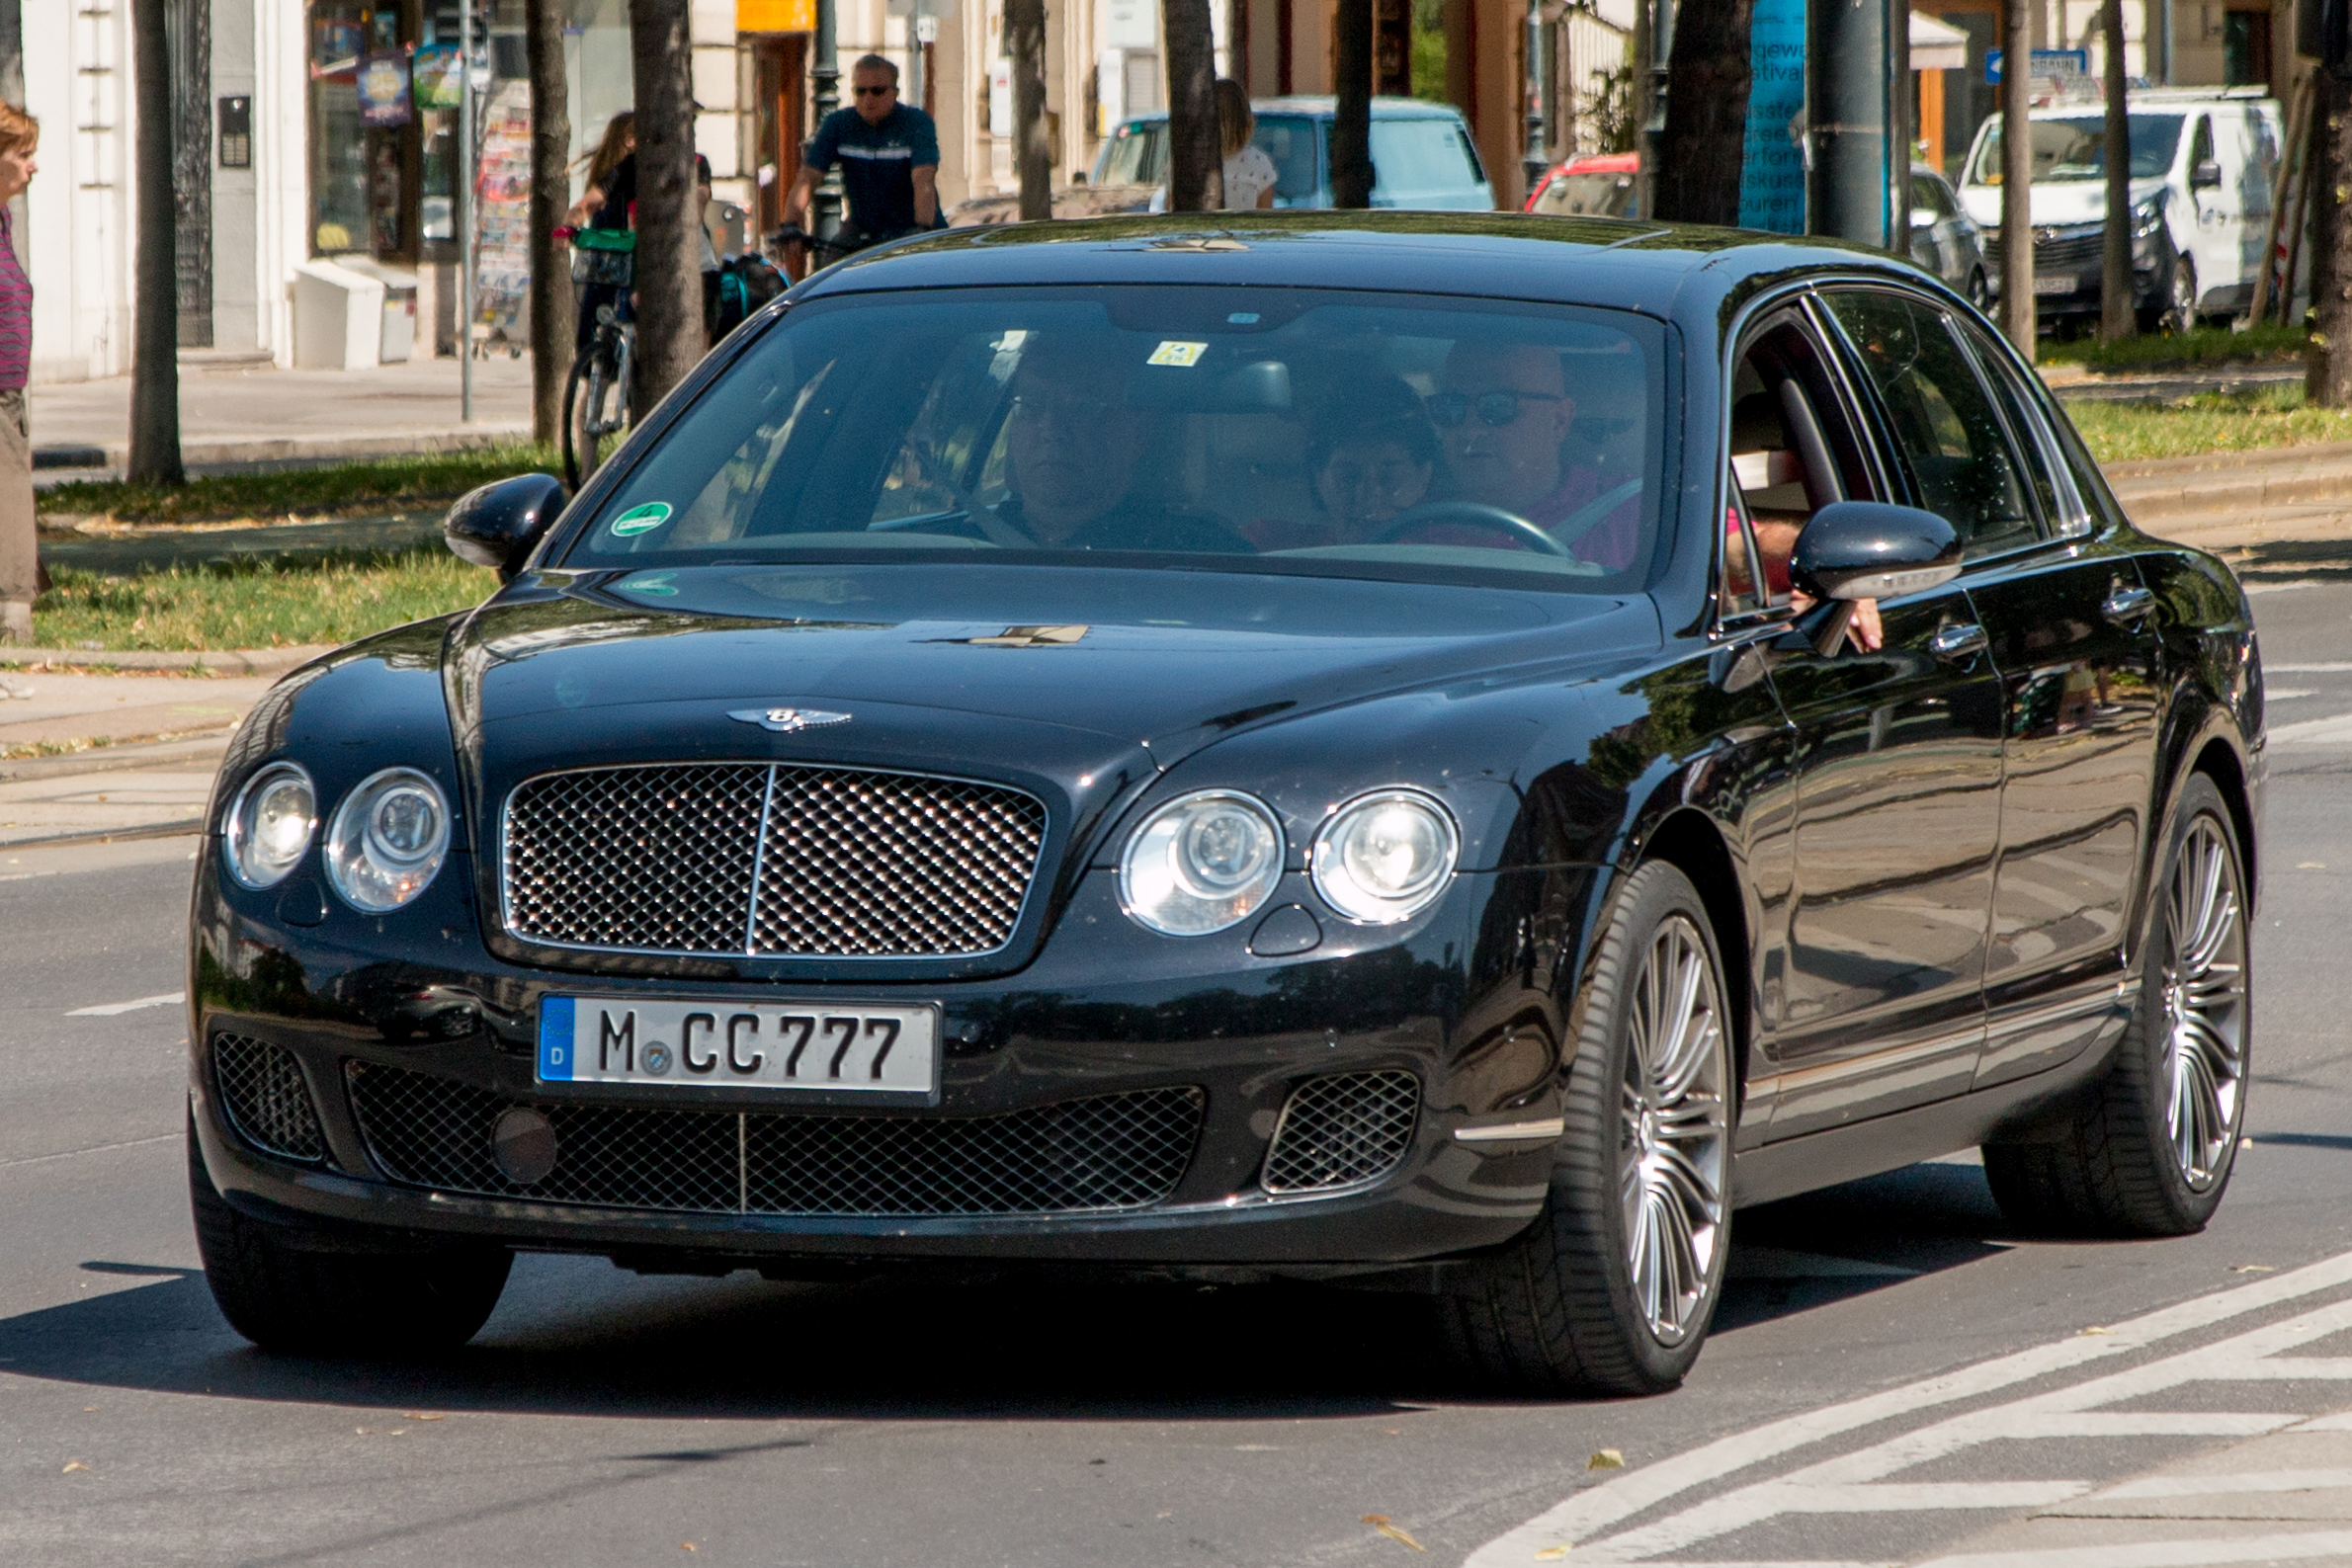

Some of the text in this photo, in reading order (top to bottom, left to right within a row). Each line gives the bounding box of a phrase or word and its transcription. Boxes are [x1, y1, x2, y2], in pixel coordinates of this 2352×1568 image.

[550, 1047, 563, 1065] D
[599, 1010, 635, 1073] M
[781, 1016, 902, 1081] 777
